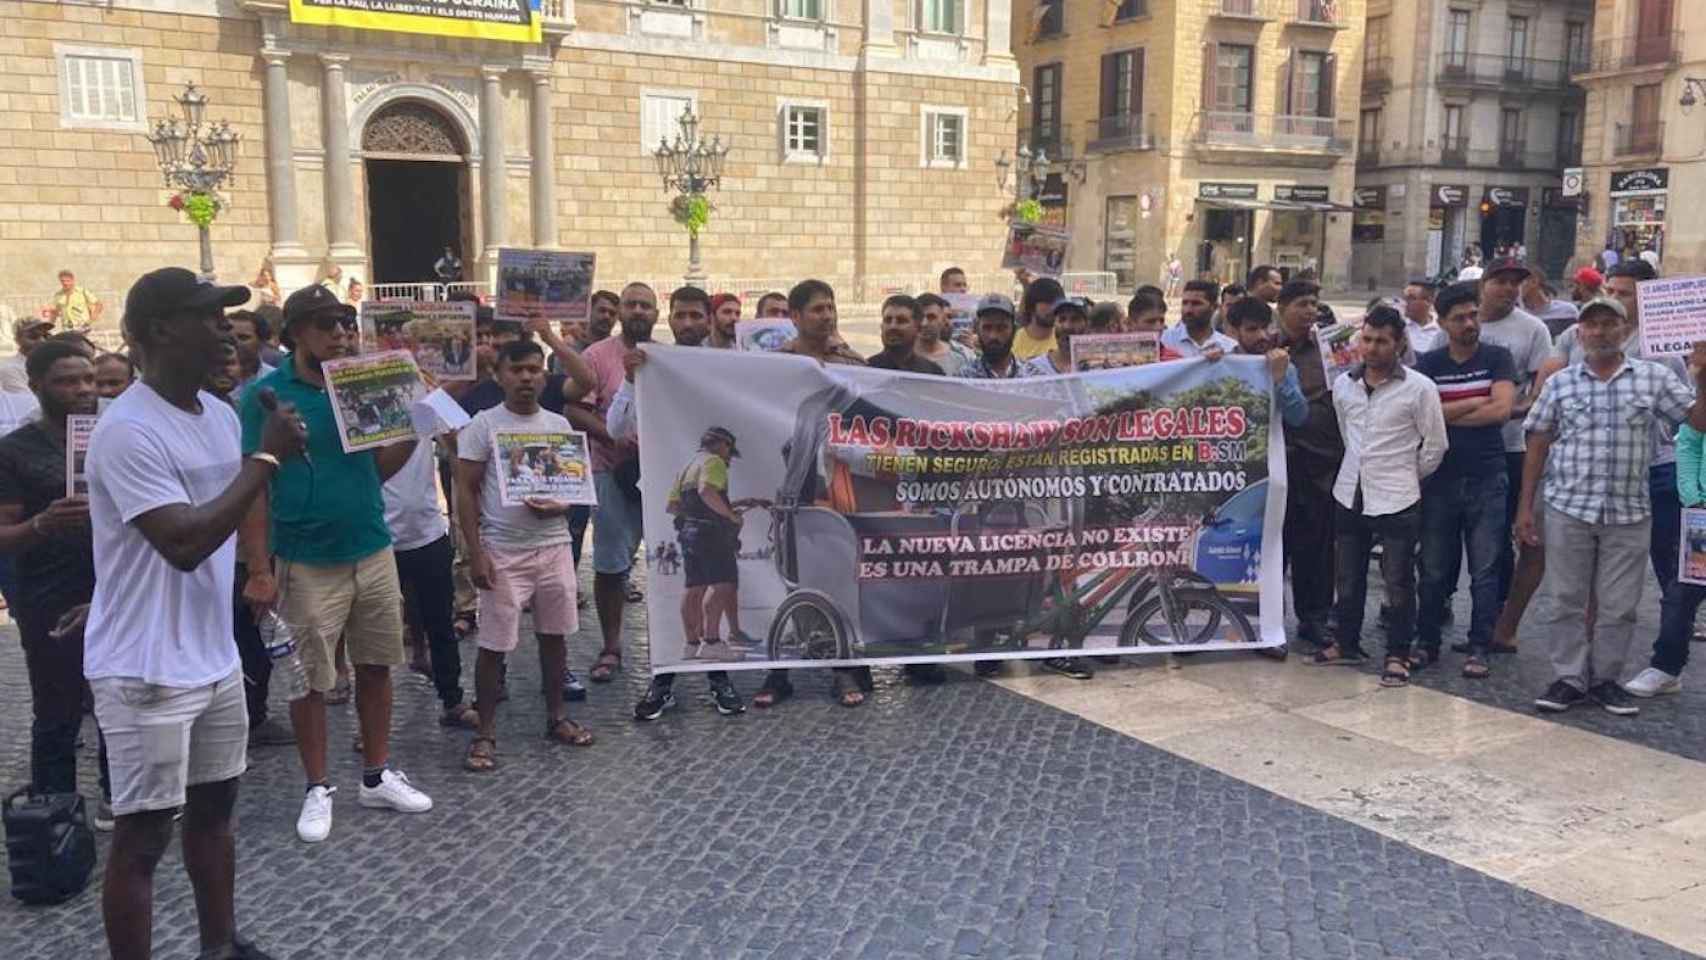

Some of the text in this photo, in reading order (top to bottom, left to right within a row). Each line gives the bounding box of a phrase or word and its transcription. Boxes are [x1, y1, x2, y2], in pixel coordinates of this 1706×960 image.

[371, 1, 384, 10] LA
[1651, 341, 1696, 353] ILEGA
[828, 406, 1246, 452] LAS RICKSHAW SON LEGALES
[867, 454, 928, 473] TIENEN
[1058, 445, 1168, 466] REGISTRADAS
[1172, 445, 1194, 462] EN
[895, 471, 1246, 502] SOMOS AUTÓNOMOS Y CONTRATADOS
[864, 538, 894, 555] LA
[898, 536, 976, 554] NUEVA
[980, 532, 1076, 552] LICENCIA
[1081, 529, 1110, 546] NO
[860, 550, 1188, 578] ES UNA TRAMPA DE COLLBONI
